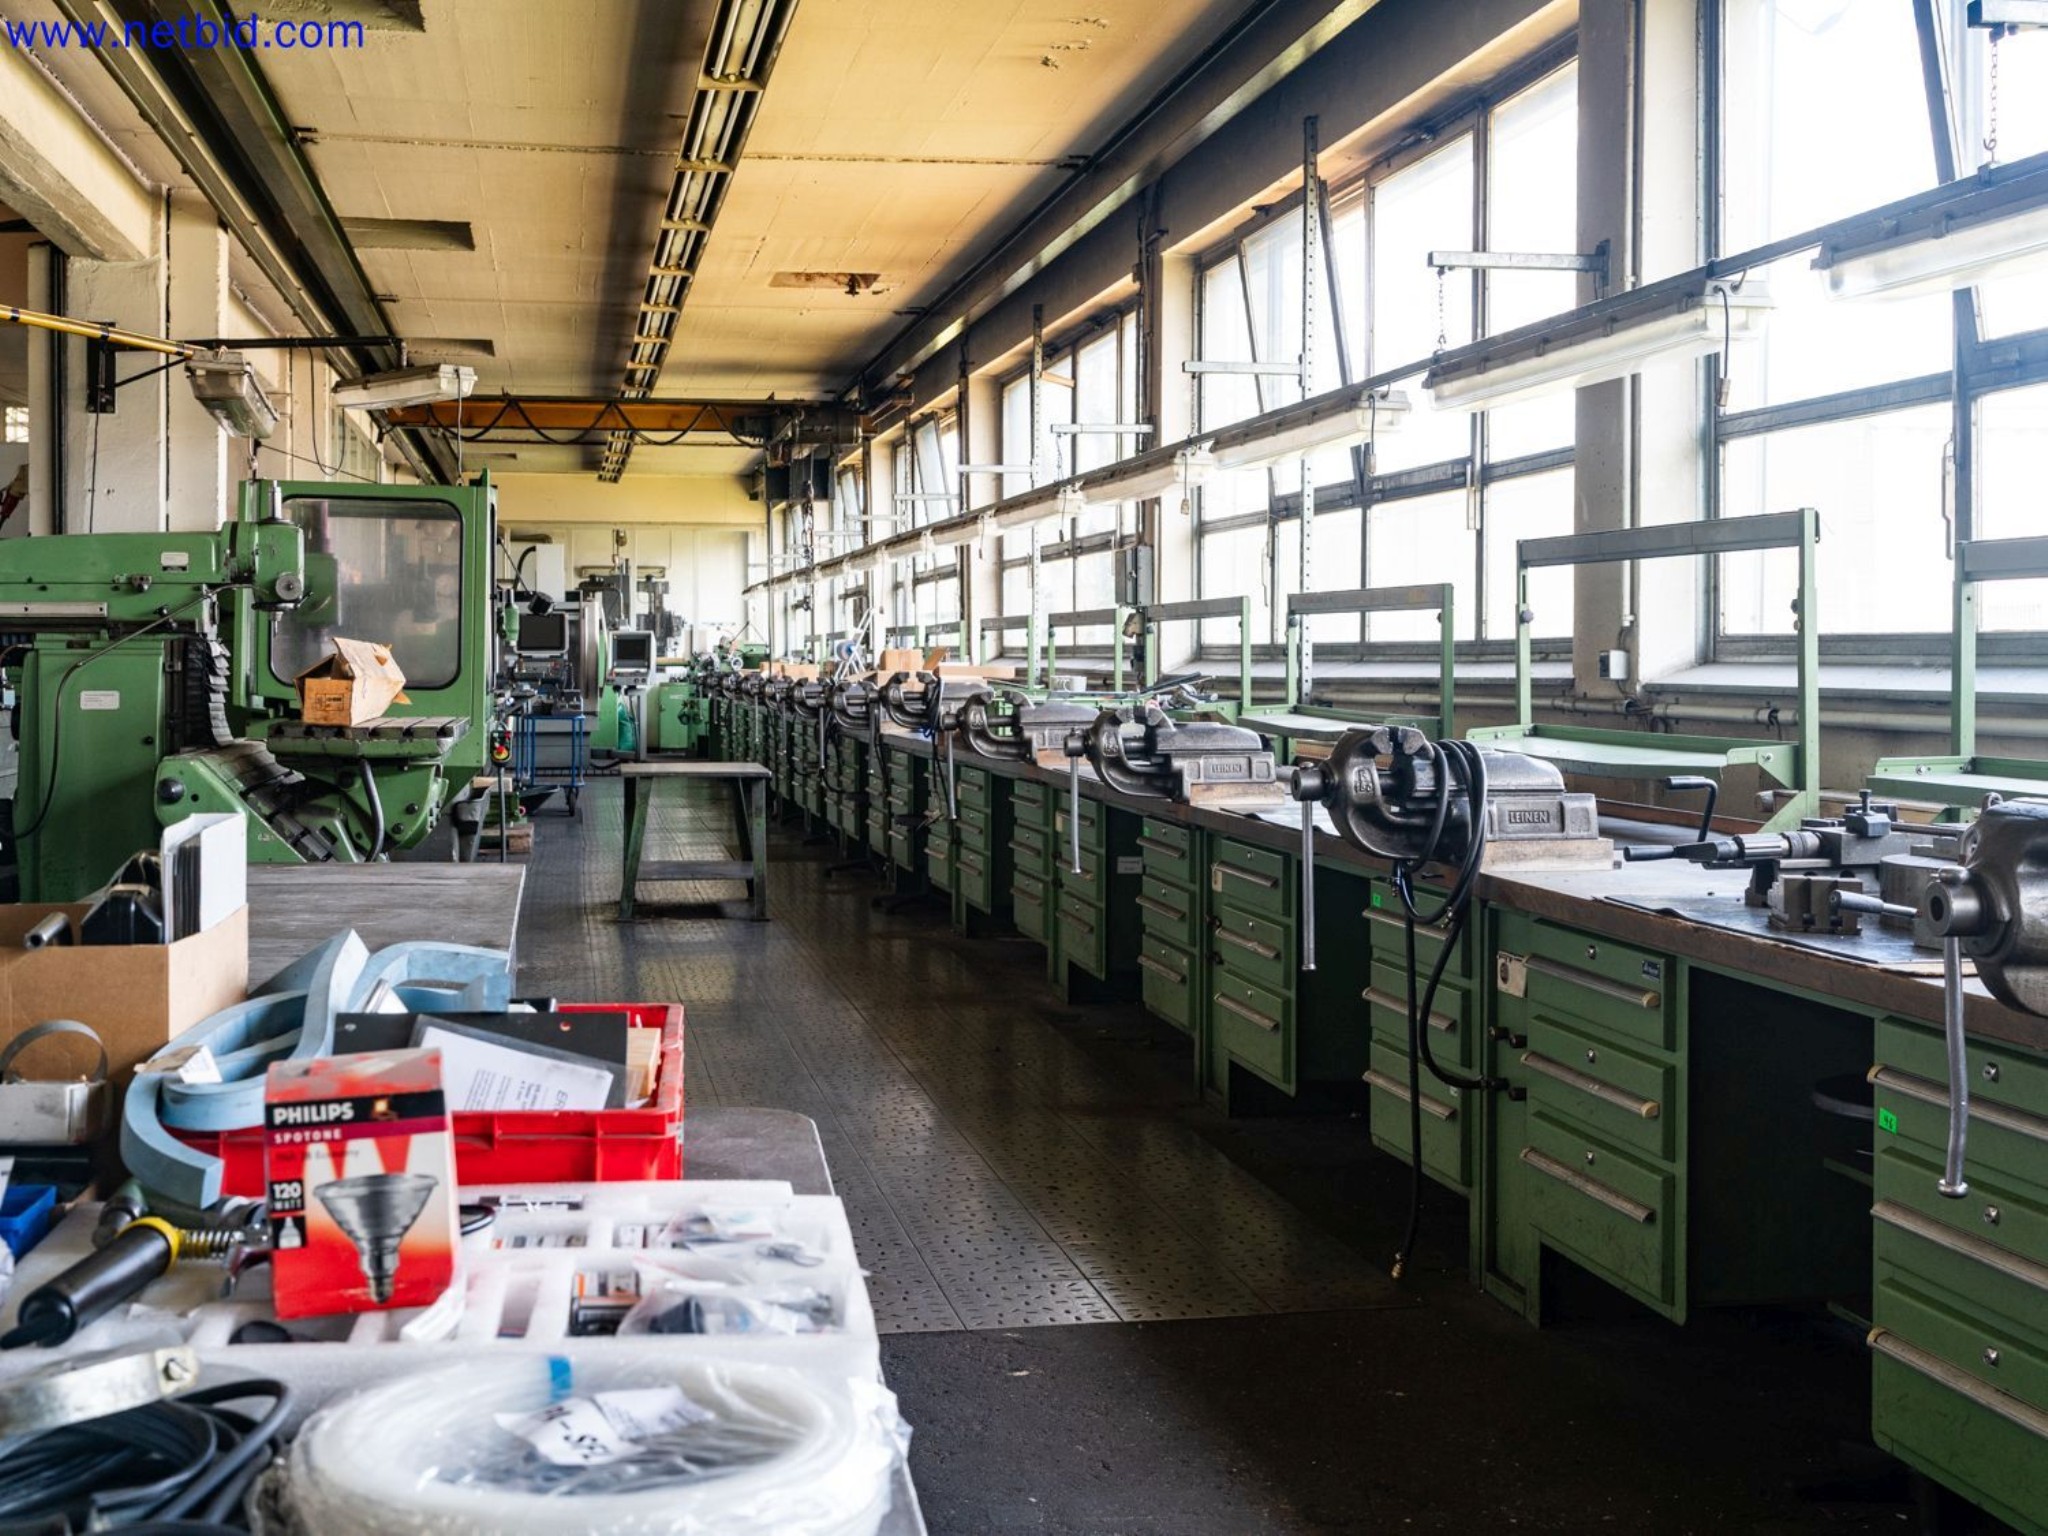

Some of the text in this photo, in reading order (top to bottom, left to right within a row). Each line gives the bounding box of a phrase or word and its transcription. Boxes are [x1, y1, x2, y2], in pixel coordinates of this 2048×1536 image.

[1509, 811, 1549, 823] LEINEN
[273, 1102, 354, 1126] PHILIPS
[274, 1129, 342, 1145] SPOTONE
[272, 1182, 302, 1199] 120
[274, 1200, 302, 1211] WATT
